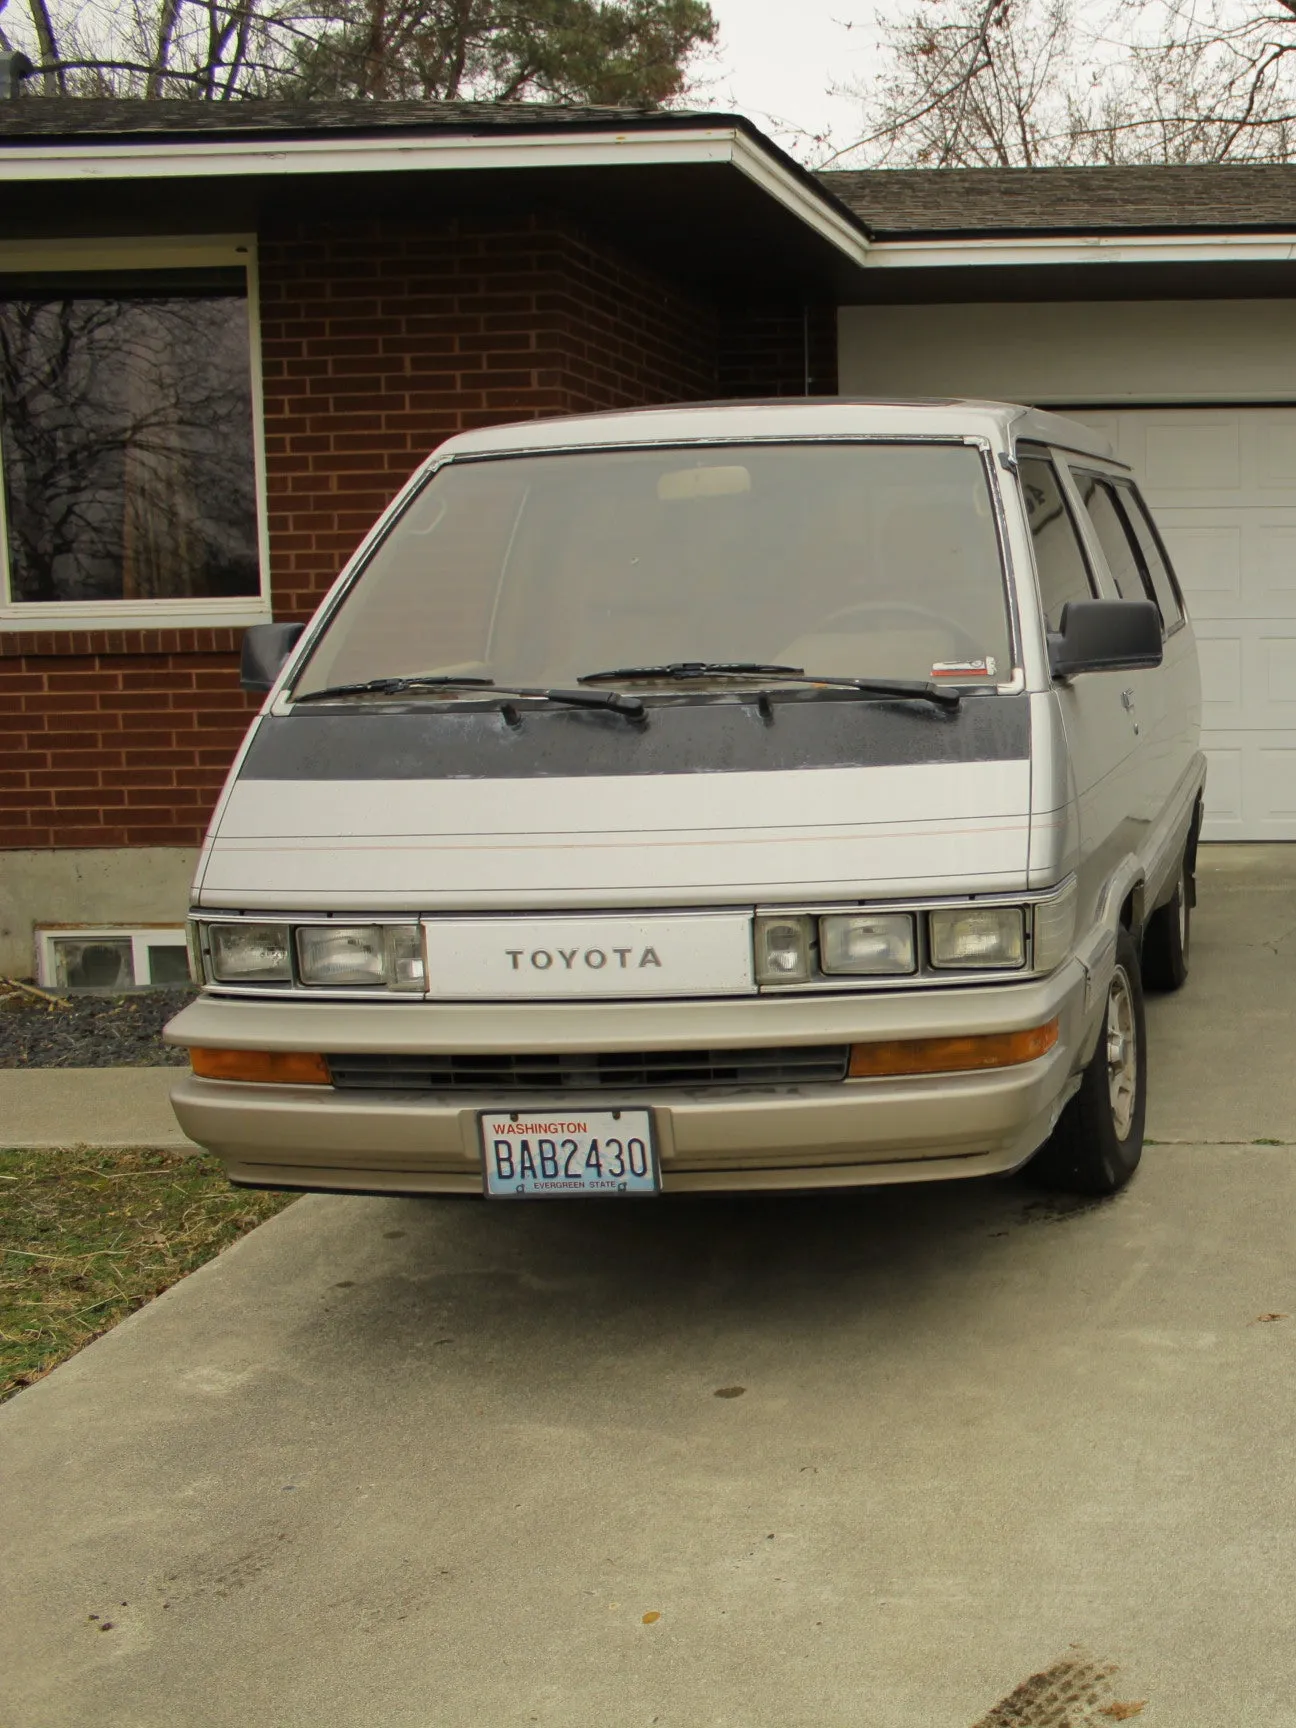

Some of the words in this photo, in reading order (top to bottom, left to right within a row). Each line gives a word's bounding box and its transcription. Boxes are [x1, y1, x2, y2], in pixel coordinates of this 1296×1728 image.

[505, 946, 662, 970] TOYOTA
[493, 1122, 588, 1135] WASHINGTON
[494, 1137, 648, 1180] BAB2430
[533, 1181, 585, 1190] EVERGREEN
[589, 1181, 616, 1189] STATE
